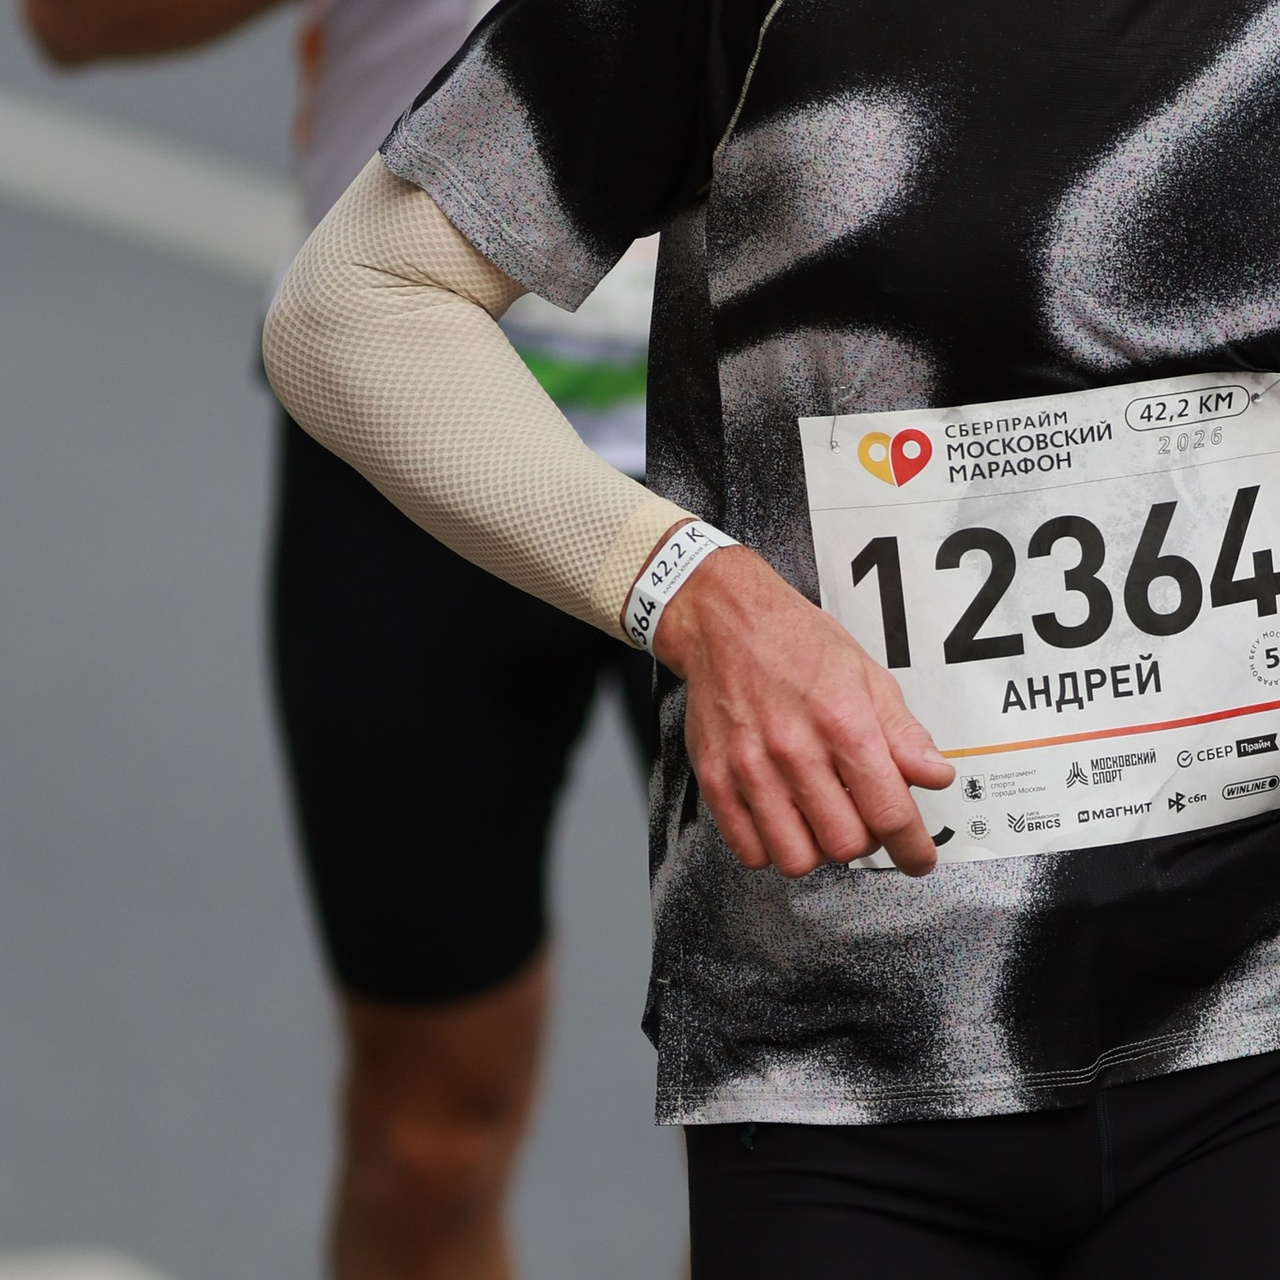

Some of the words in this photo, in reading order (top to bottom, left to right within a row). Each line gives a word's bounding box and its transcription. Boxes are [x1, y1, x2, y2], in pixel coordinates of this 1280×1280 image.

[1139, 398, 1189, 423] 42,2
[1199, 392, 1234, 415] КМ
[945, 411, 1068, 439] СБЕРПРАЙМ
[947, 420, 1113, 461] МОСКОВСКИЙ
[1158, 426, 1224, 455] 2026
[949, 452, 1072, 483] МАРАФОН
[631, 596, 657, 646] 364
[651, 542, 687, 587] 42,2
[685, 527, 706, 543] К
[1265, 647, 1280, 669] 5
[1002, 653, 1163, 714] АНДРЕЙ
[1091, 748, 1157, 772] МОСКОВСКИЙ
[1196, 745, 1234, 762] СБЕР
[1240, 740, 1272, 754] Прайм
[989, 769, 1037, 782] Департамент
[990, 780, 1016, 790] спорта
[1092, 769, 1123, 785] СПОРТ
[991, 789, 1017, 798] города
[1018, 785, 1046, 794] Москвы
[1188, 794, 1207, 804] сбп
[1226, 781, 1268, 797] WINLINE
[1027, 818, 1062, 832] BRICS
